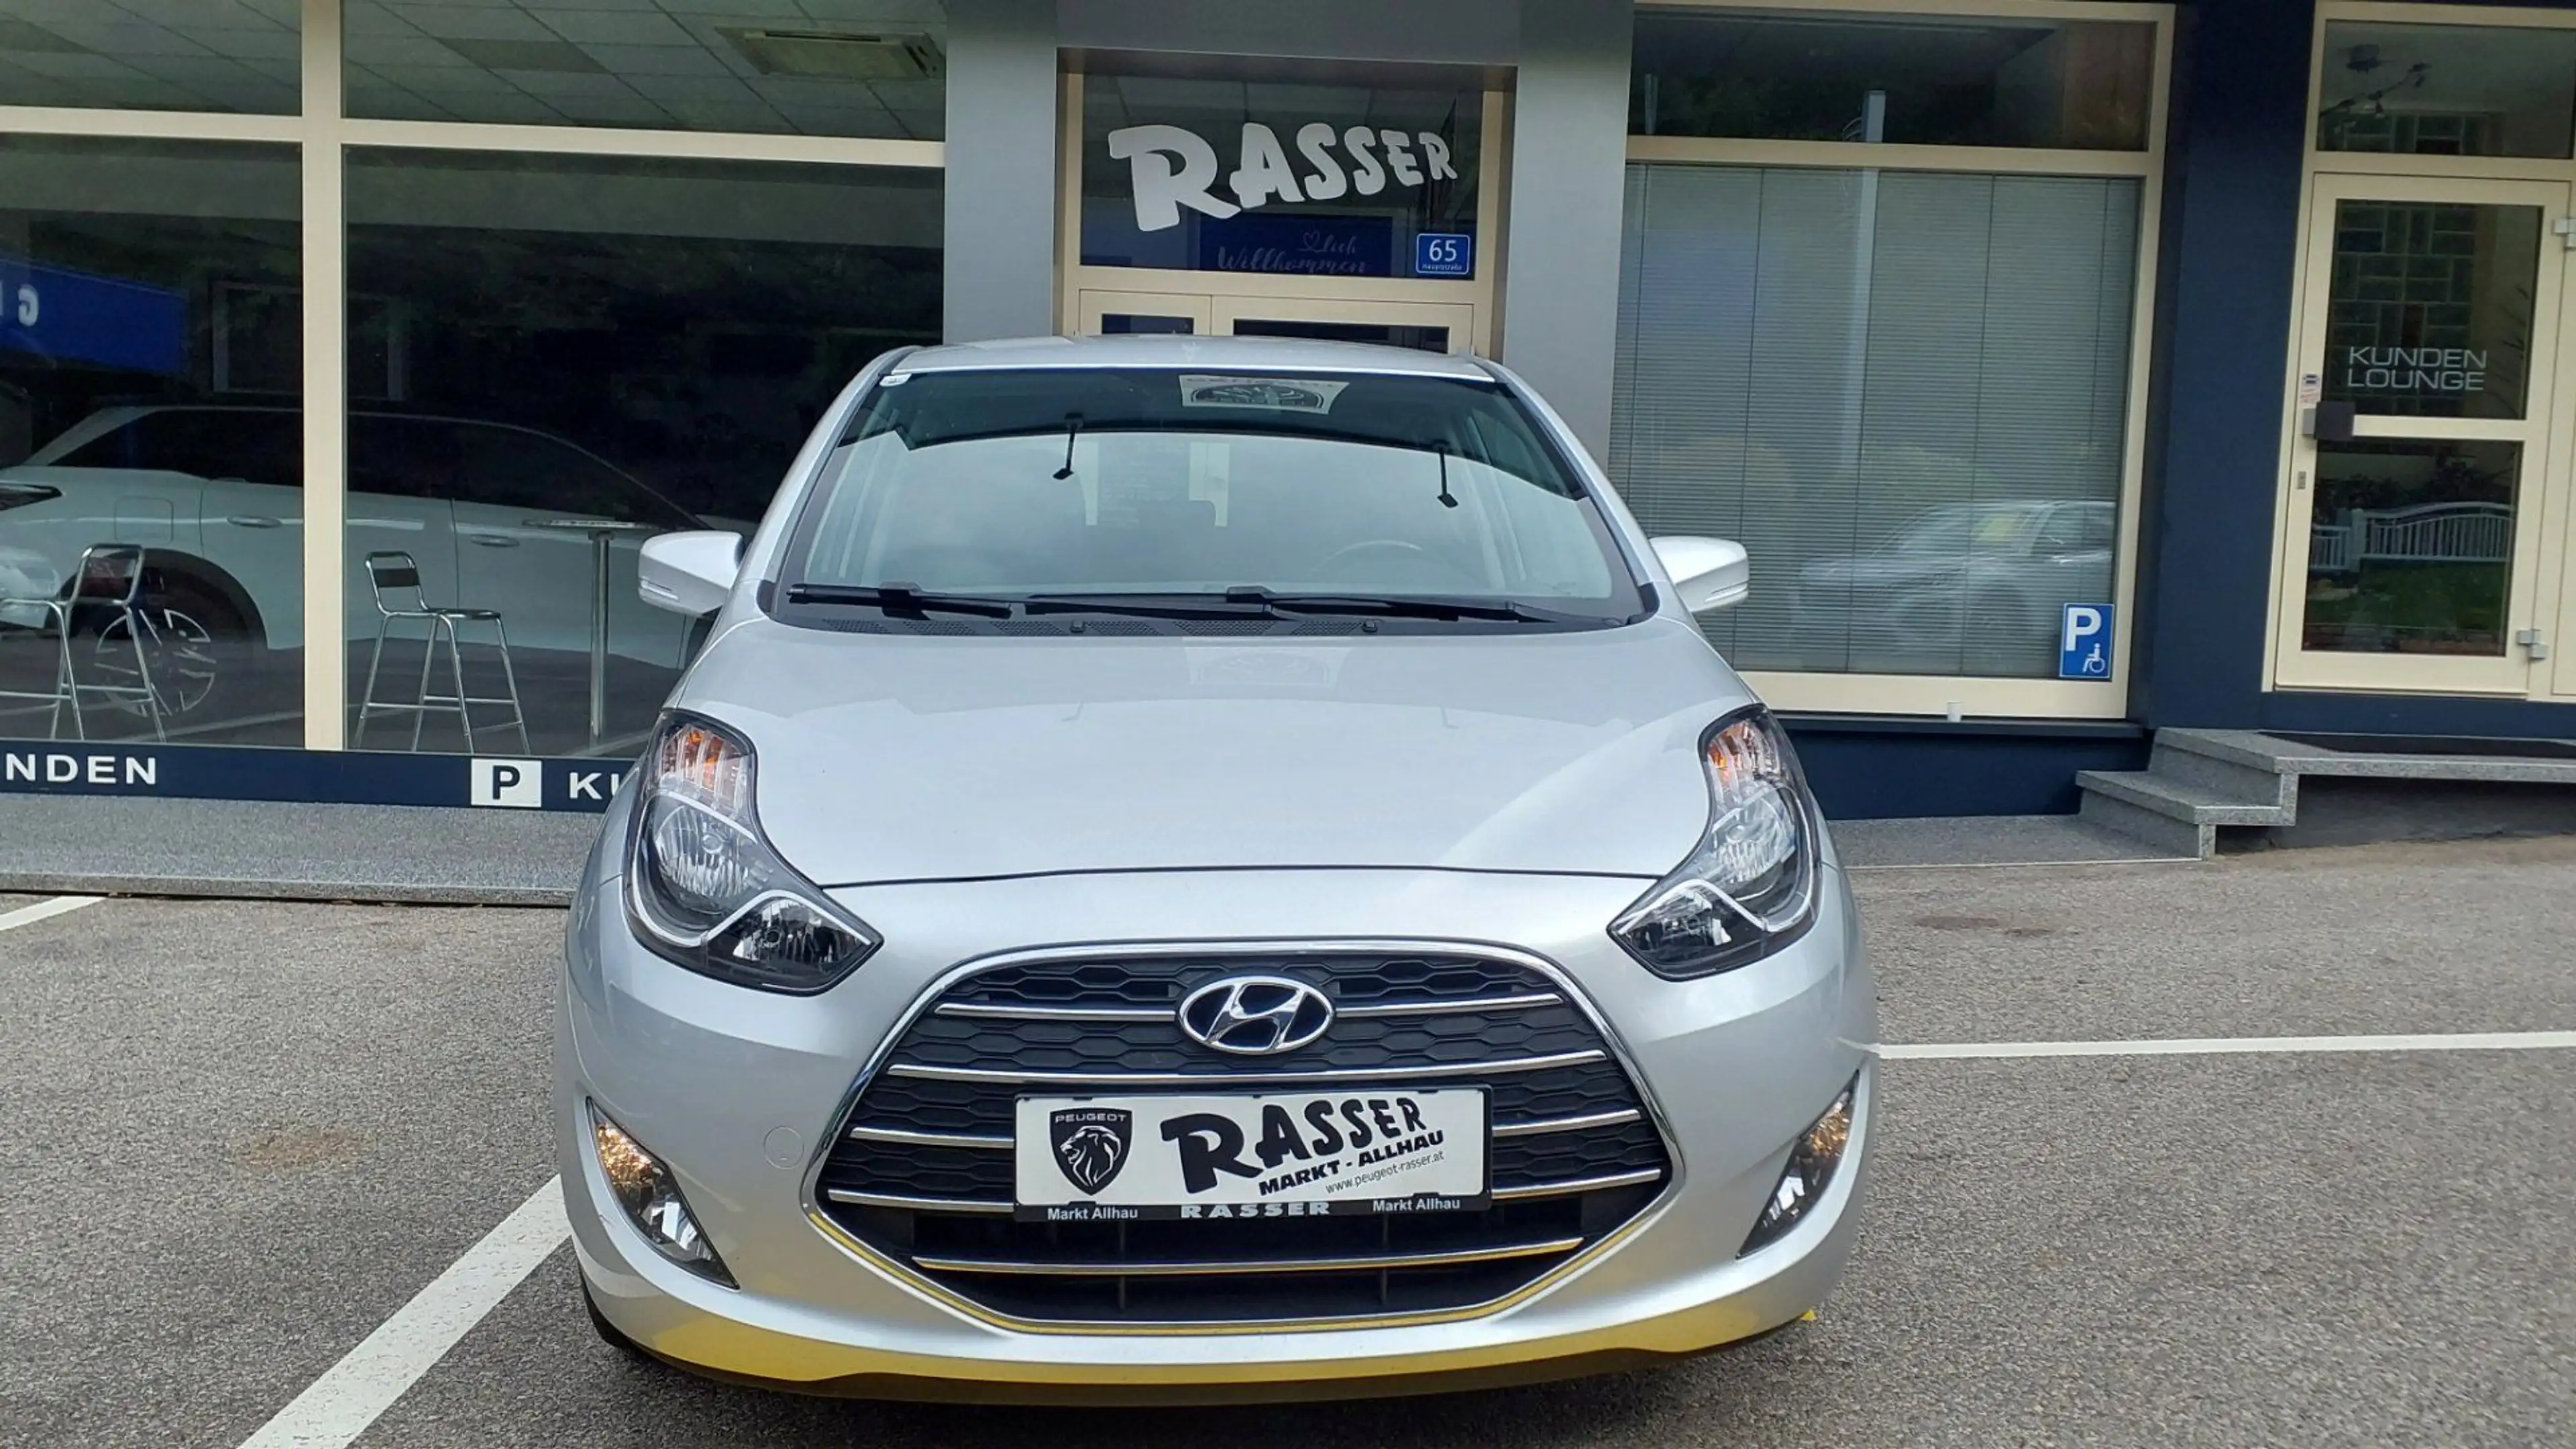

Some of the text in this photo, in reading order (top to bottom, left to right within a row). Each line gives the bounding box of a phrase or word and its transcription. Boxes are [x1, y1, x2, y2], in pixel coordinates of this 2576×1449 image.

[1108, 122, 1458, 231] RASSER
[1429, 239, 1457, 262] 65
[2349, 346, 2487, 368] KUNDEN
[2348, 368, 2485, 390] LOUNGE
[2065, 607, 2102, 651] P
[5, 753, 156, 785] NDEN
[491, 765, 521, 800] P
[1055, 1113, 1127, 1123] PEUGEOT
[1161, 1097, 1428, 1194] RASSER
[1258, 1159, 1340, 1195] MARKT
[1358, 1130, 1444, 1167] ALLHAU
[1325, 1150, 1445, 1194] www.peugeot-rasser.at
[1047, 1207, 1138, 1220] Markt Allhau
[1181, 1201, 1330, 1219] RASSER
[1373, 1197, 1460, 1213] Markt Allhau
